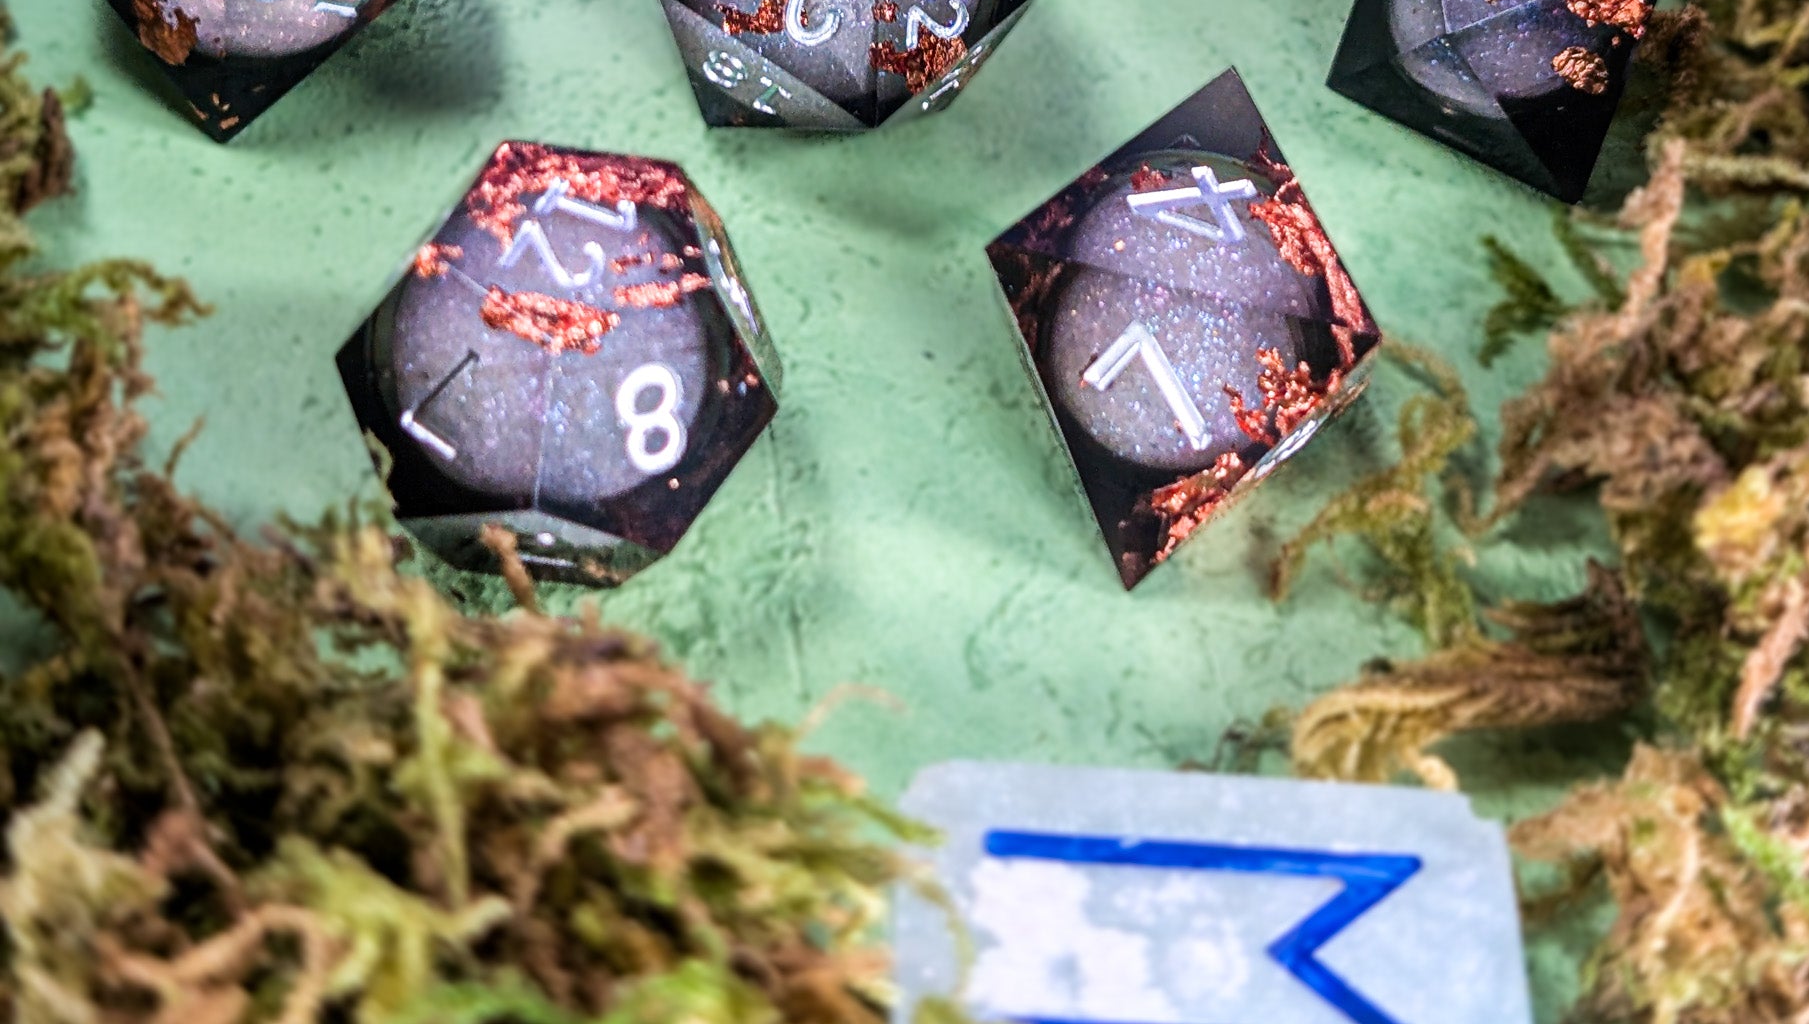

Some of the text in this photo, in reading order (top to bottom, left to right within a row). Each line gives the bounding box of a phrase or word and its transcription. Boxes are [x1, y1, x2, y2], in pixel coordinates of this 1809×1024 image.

[1126, 165, 1257, 243] 4
[616, 364, 687, 473] 8
[1083, 319, 1211, 452] 7
